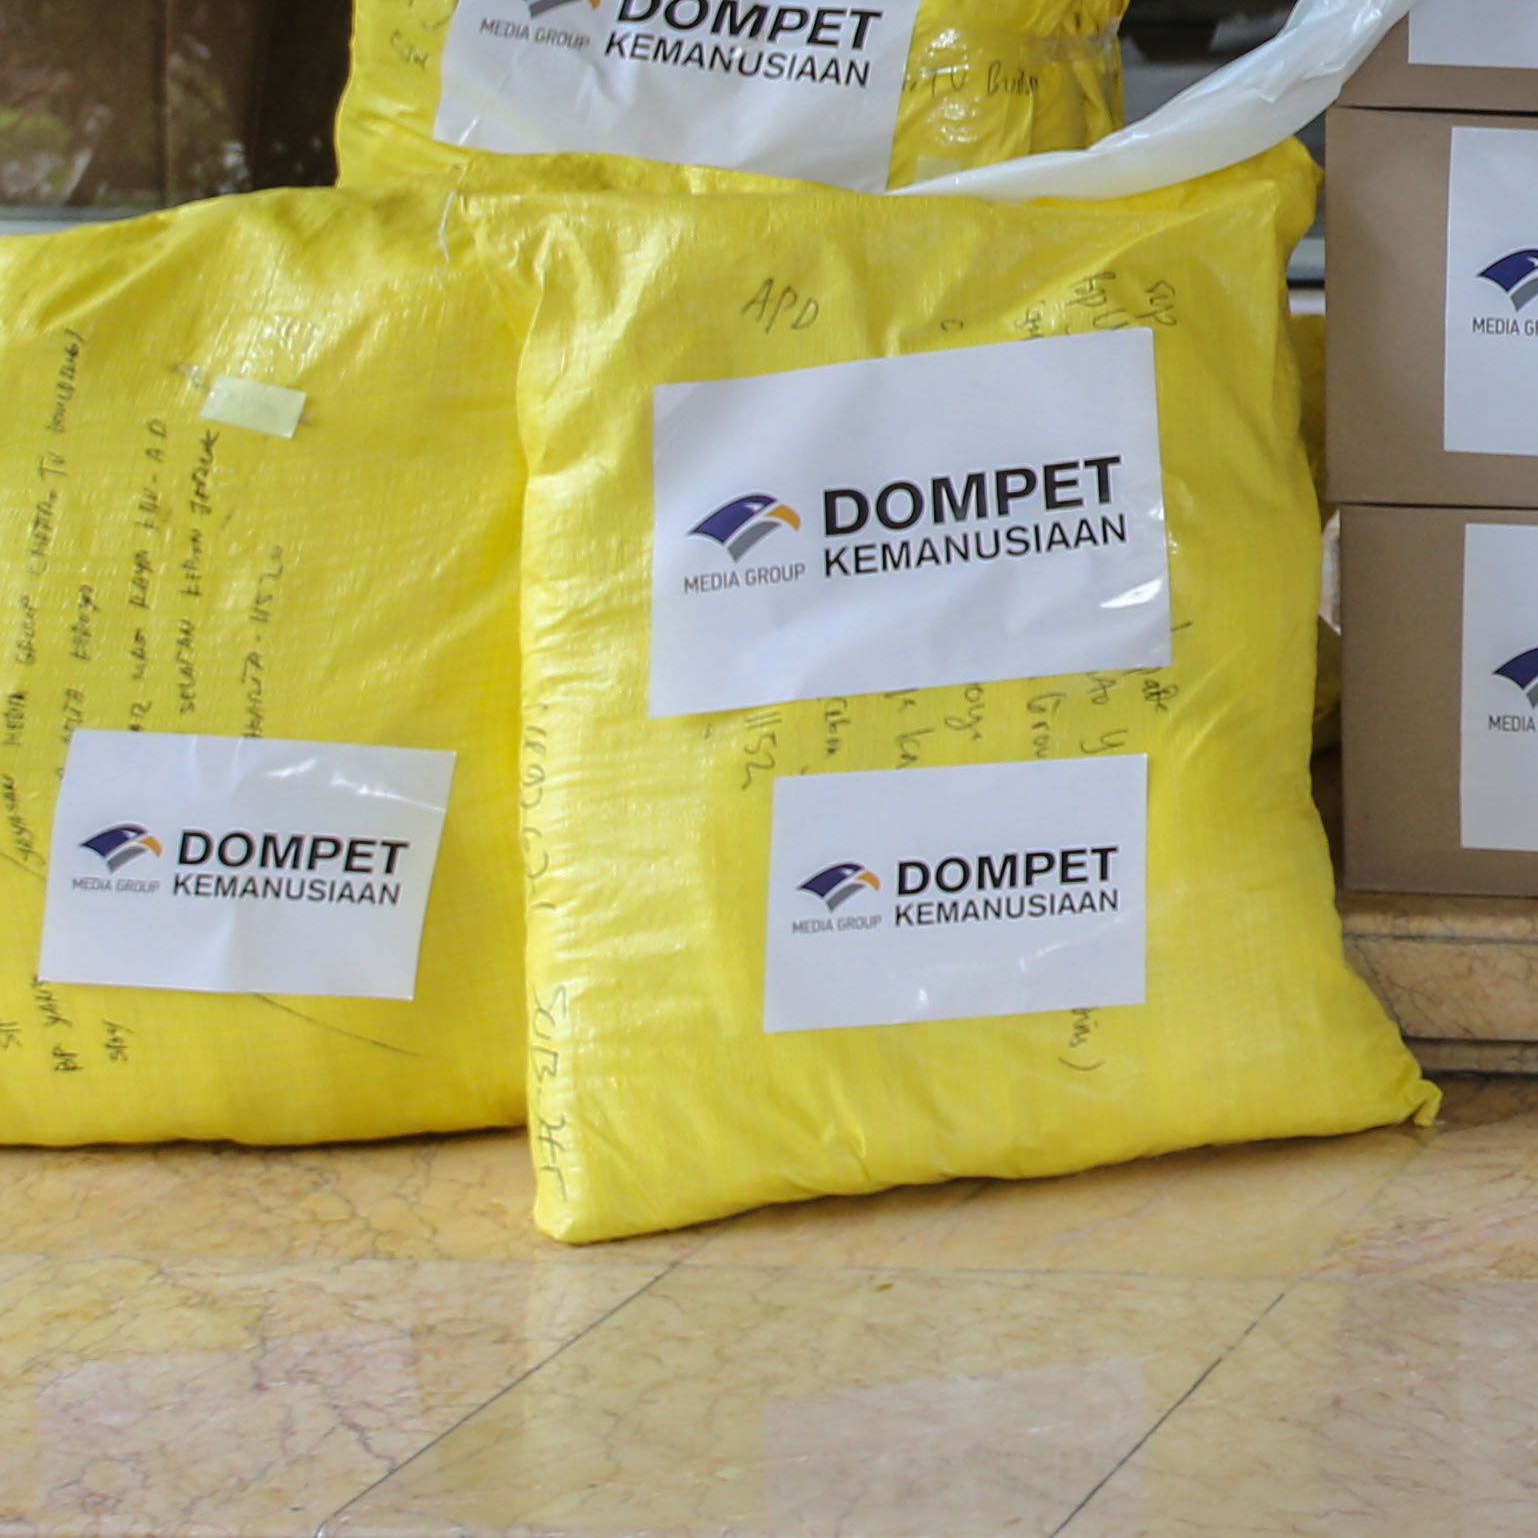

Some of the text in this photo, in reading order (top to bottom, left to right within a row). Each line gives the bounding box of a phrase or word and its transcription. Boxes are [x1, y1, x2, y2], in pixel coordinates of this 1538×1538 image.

[480, 18, 590, 52] MEDIA GROUP
[605, 30, 869, 87] KEMANUSIAAN
[741, 277, 819, 335] APD
[1473, 317, 1520, 335] MEDIA
[824, 456, 1120, 536] DOMPET
[823, 514, 1126, 578] KEMANUSIAAN
[684, 563, 805, 593] MEDIA GROUP
[1488, 715, 1536, 732] MEDIA
[178, 831, 408, 874] DOMPET
[72, 877, 160, 894] MEDIA GROUP
[173, 873, 400, 905] KEMANUSIAAN
[898, 847, 1118, 896] DOMPET
[792, 915, 882, 934] MEDIA GROUP
[896, 889, 1117, 926] KEMANUSIAAN
